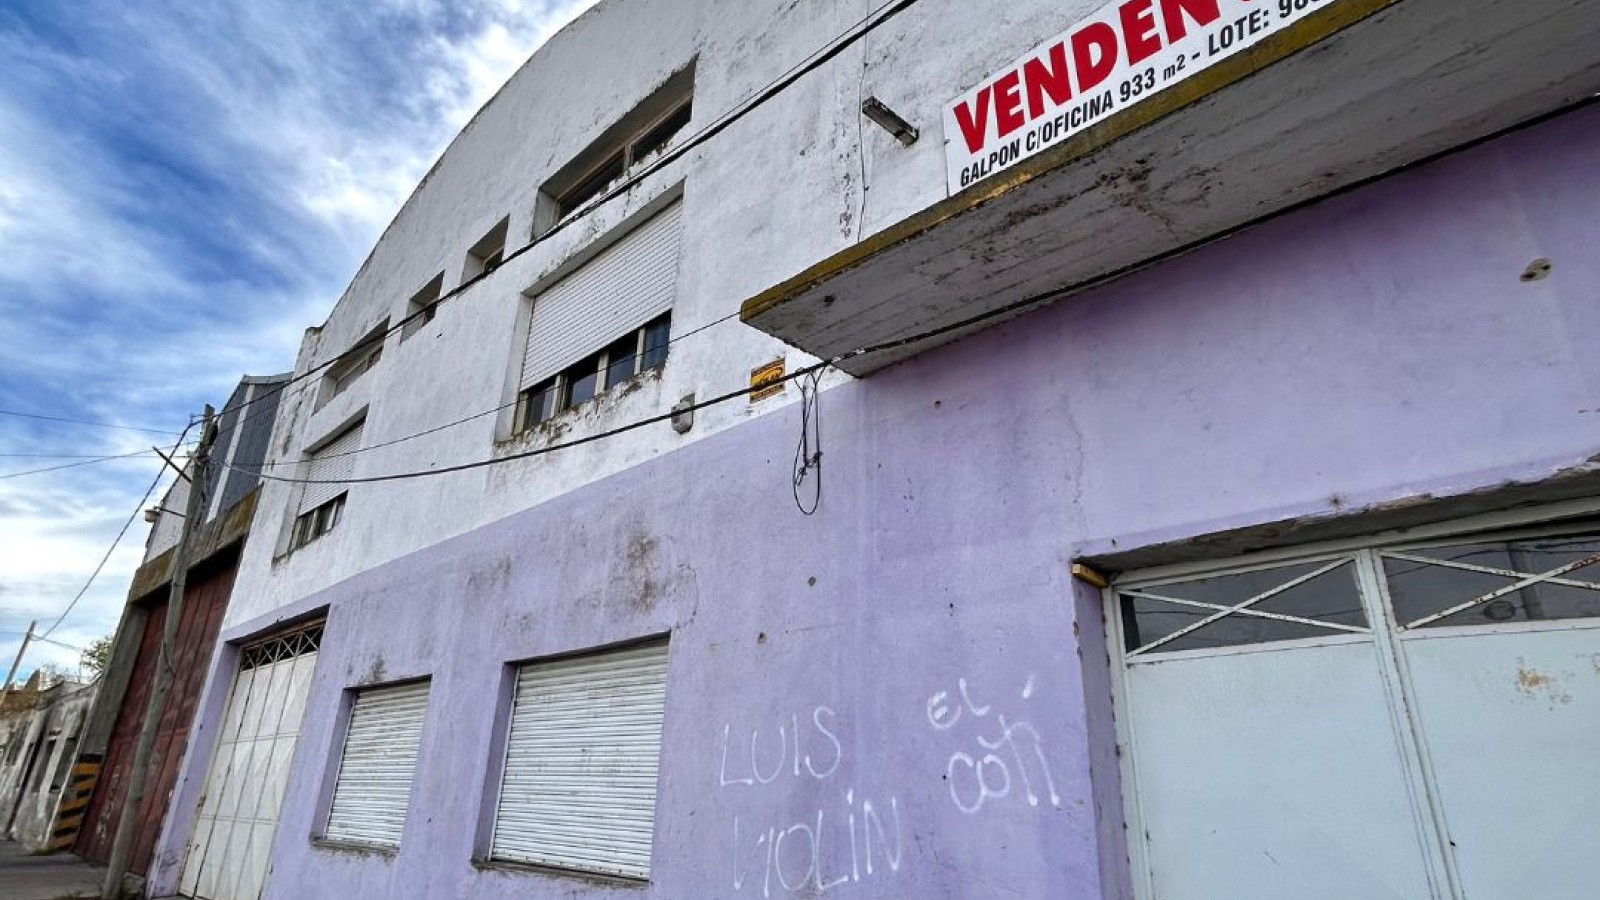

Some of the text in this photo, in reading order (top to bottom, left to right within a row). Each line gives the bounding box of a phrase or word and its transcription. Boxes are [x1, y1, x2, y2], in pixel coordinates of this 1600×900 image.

[960, 138, 1020, 187] GALPON
[1026, 89, 1113, 151] C/OFICINA
[1119, 67, 1155, 103] 933
[1208, 8, 1269, 57] LOTE:
[720, 706, 841, 785] LUIS
